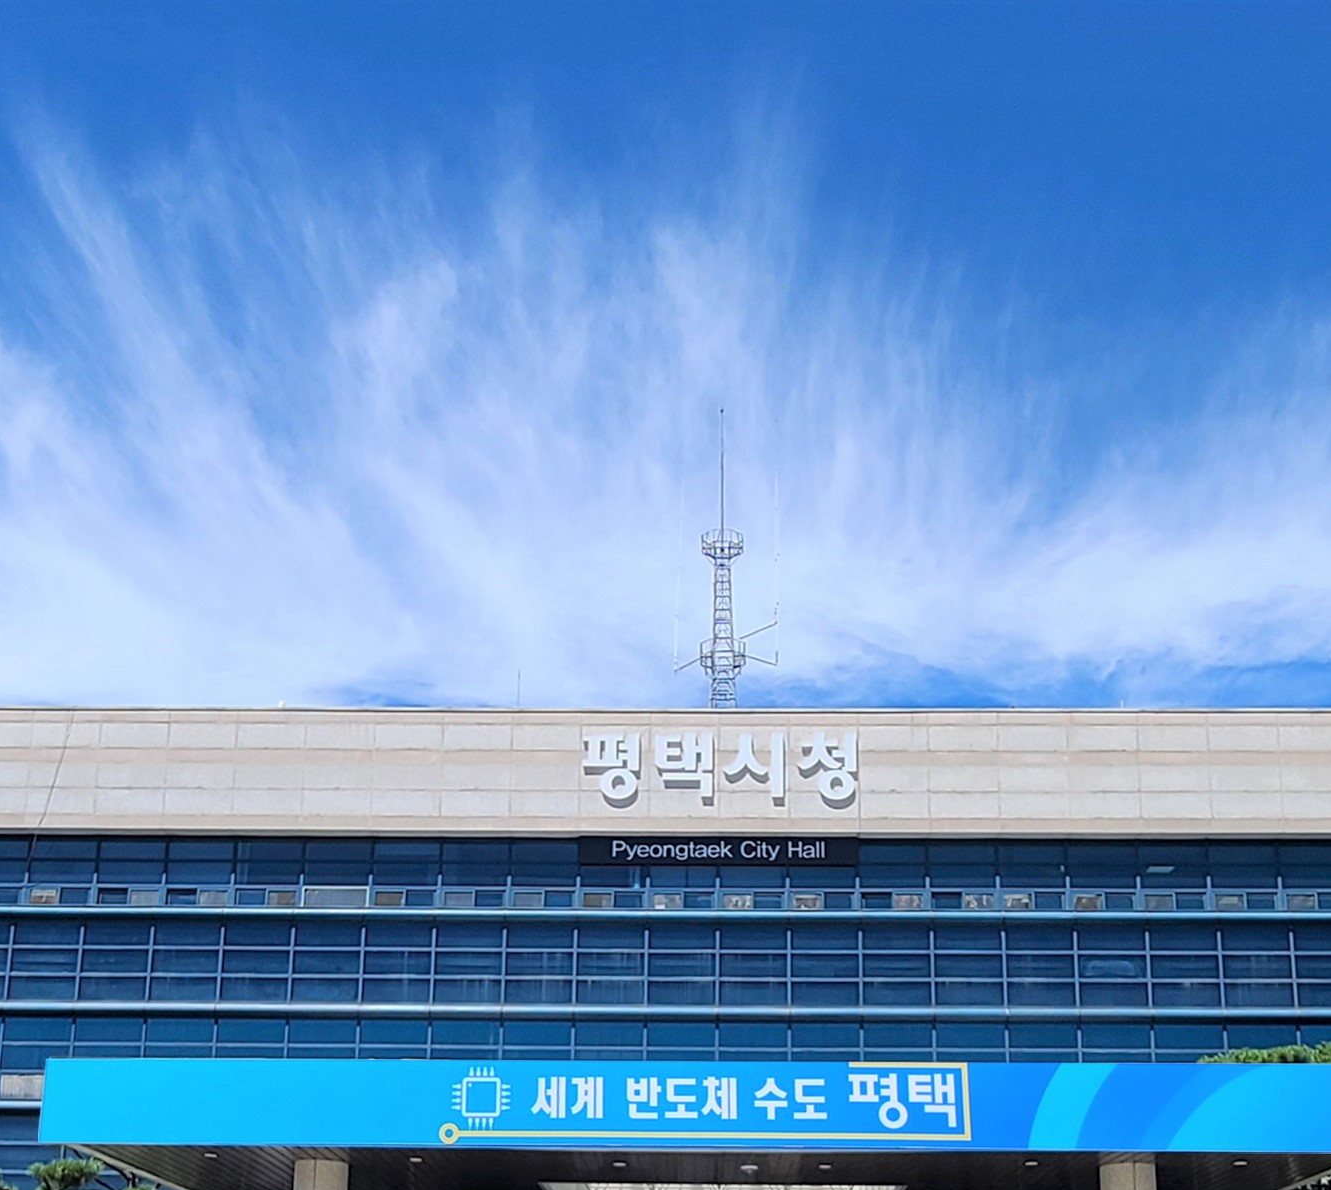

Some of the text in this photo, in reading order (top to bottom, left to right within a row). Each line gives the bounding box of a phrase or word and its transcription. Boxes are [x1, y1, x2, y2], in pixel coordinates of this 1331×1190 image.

[582, 732, 858, 808] 평택시청
[611, 840, 825, 861] Pyeongtaek City Hall
[531, 1074, 957, 1128] 세계 반도체 수도 평택
